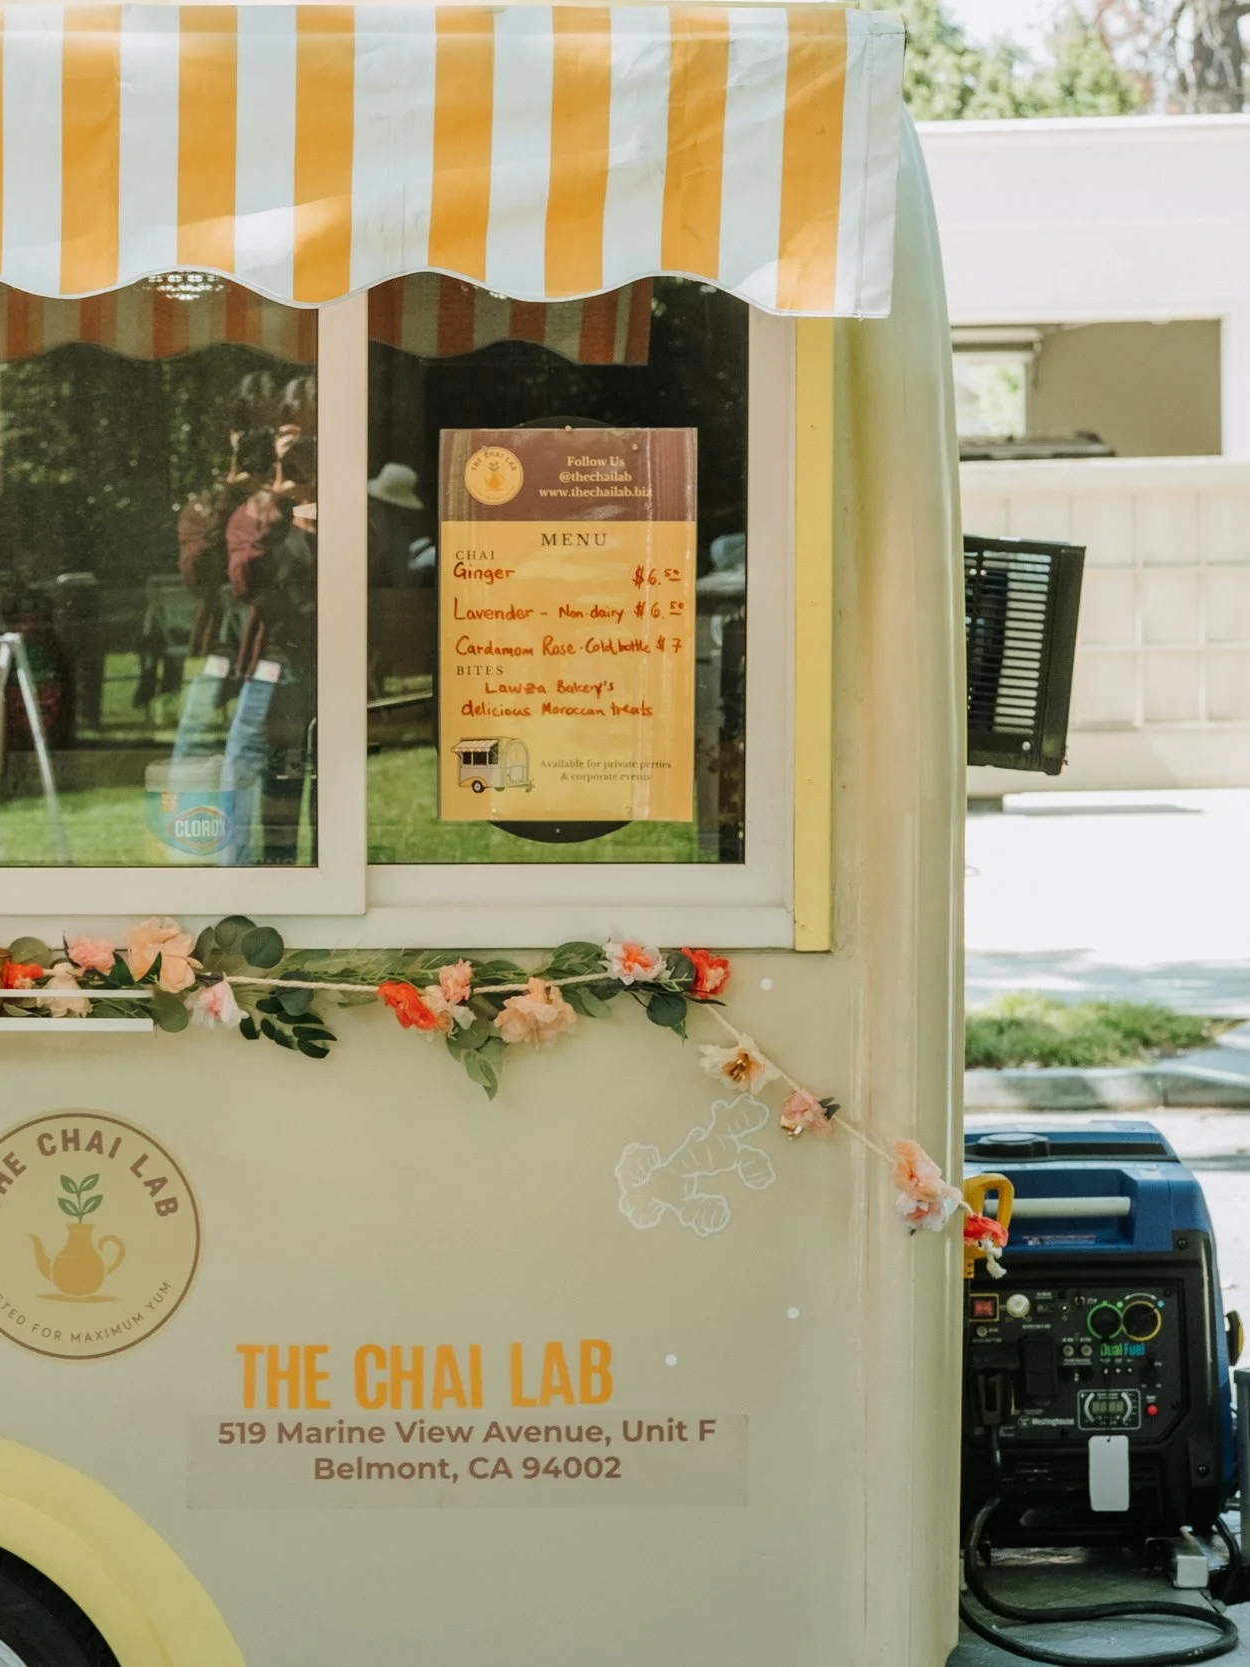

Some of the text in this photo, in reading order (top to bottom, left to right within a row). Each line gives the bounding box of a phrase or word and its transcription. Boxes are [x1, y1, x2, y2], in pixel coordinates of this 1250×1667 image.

[566, 456, 625, 467] Follow Us
[559, 471, 632, 483] @thechailab
[539, 487, 653, 498] www.thechailab.biz
[541, 533, 608, 546] MENU
[455, 550, 495, 560] CHAI
[453, 561, 515, 585] Ginger
[453, 597, 534, 621] Lavender
[455, 635, 534, 656] Cardamom
[456, 665, 504, 676] BITES
[461, 701, 653, 717] delicious Moroccan treats
[540, 759, 672, 770] Available for private parties
[571, 773, 618, 783] corporate
[175, 819, 226, 838] CLOROX
[36, 1127, 123, 1160] CHAI
[129, 1152, 180, 1218] LAB
[31, 1322, 63, 1342] FOR
[70, 1311, 145, 1344] MAXIMUM
[146, 1280, 172, 1312] YUM
[1100, 1343, 1145, 1356] Dual Fuel
[235, 1338, 614, 1411] THE CHAI LAB
[218, 1418, 717, 1447] 519 Marine View Avenue, Unit F
[314, 1456, 622, 1483] Belmont, CA 94002
